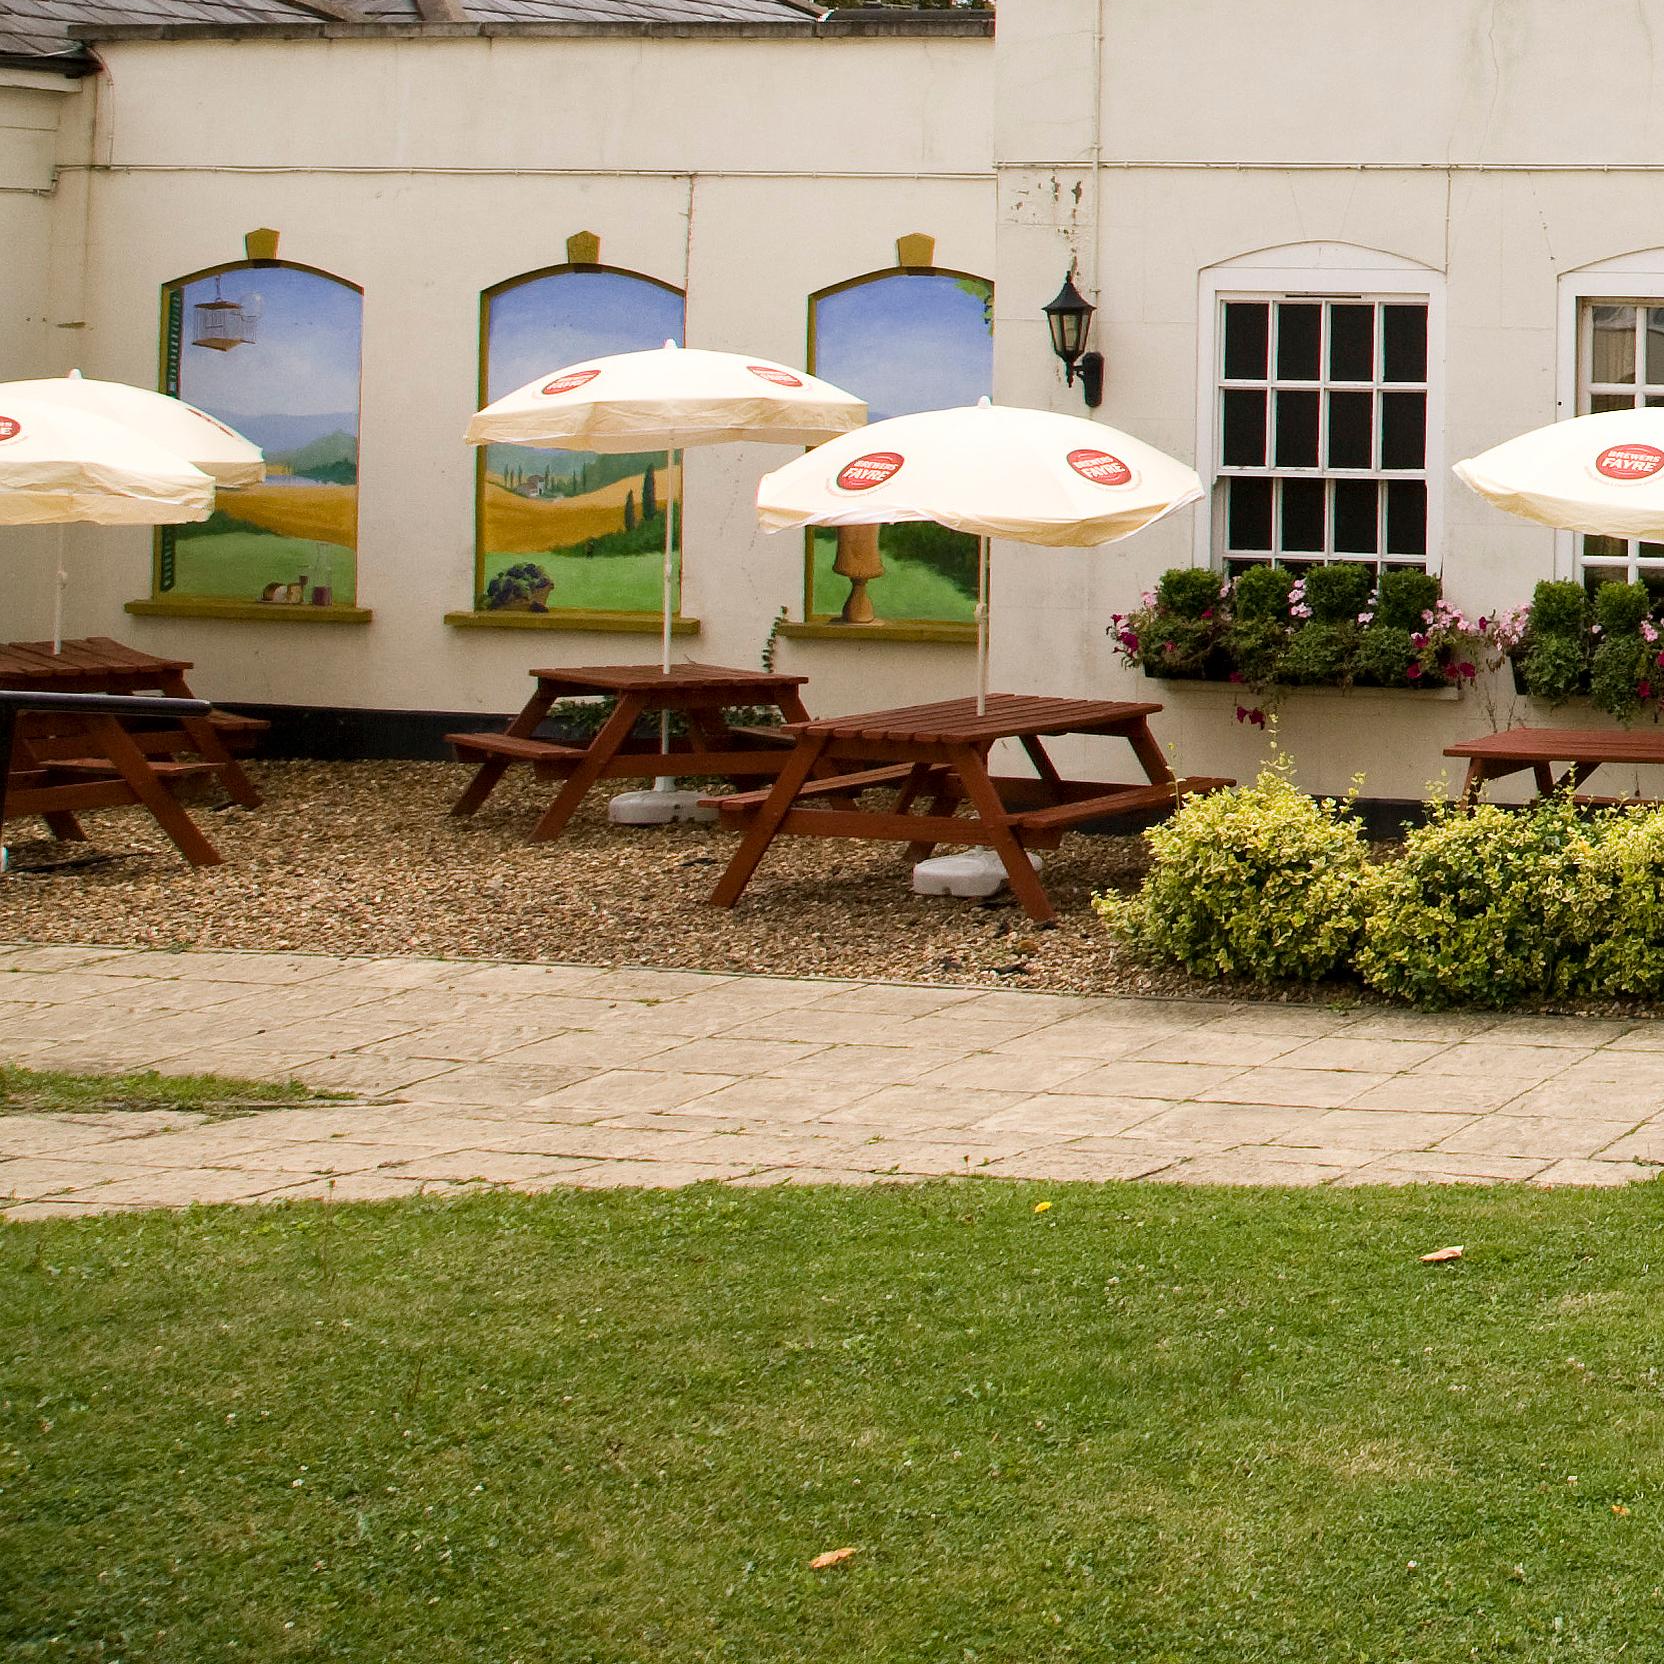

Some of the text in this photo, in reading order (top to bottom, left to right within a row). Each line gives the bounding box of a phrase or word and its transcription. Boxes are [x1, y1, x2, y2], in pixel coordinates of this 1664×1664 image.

[1607, 450, 1662, 463] BREWERS
[1080, 462, 1126, 478] FAYRE
[1601, 457, 1657, 472] FAYRE
[841, 467, 892, 481] FAYRE
